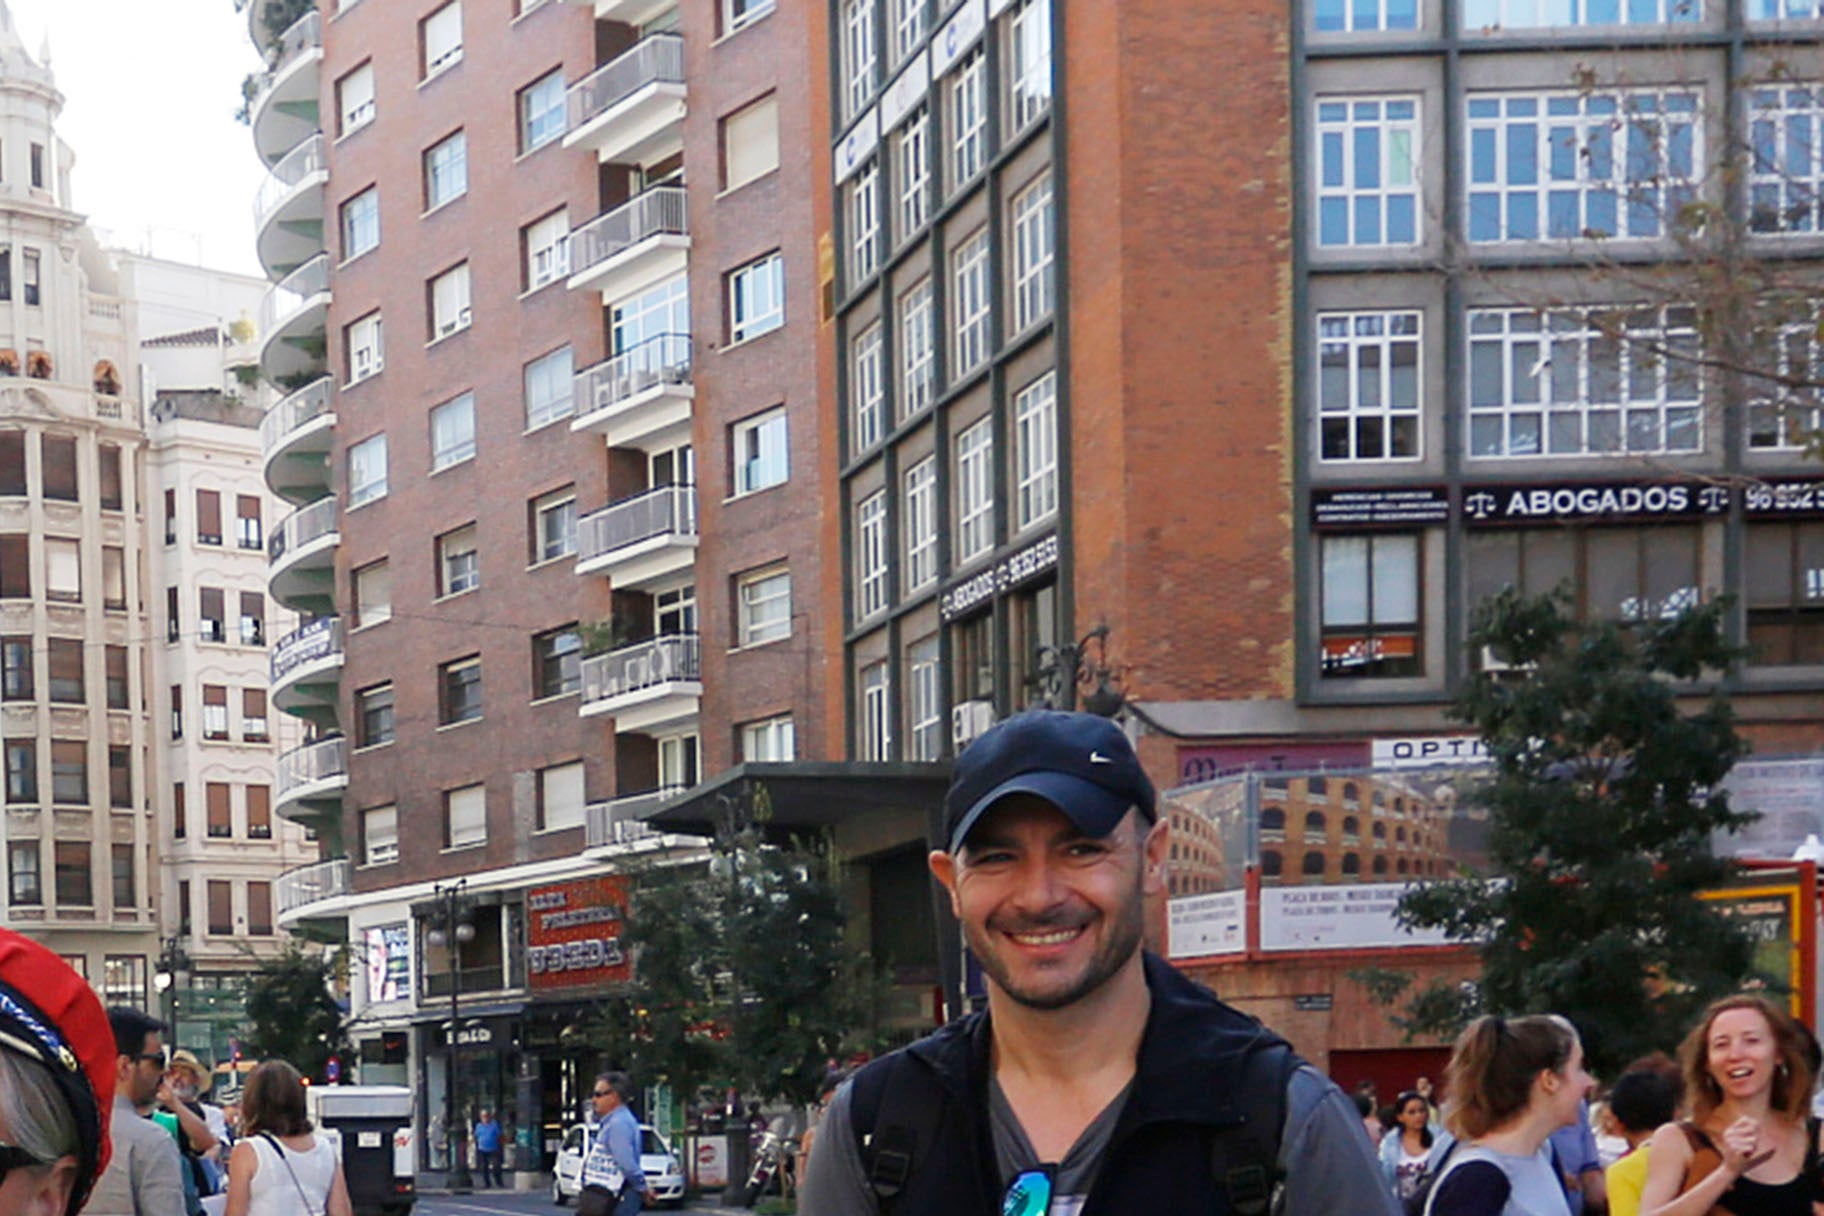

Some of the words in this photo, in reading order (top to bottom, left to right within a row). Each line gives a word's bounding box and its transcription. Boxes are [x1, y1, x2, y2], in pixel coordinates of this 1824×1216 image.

[1506, 486, 1689, 516] ABOGADOS
[1745, 484, 1773, 510] 96
[953, 570, 994, 612] ABOGADOS
